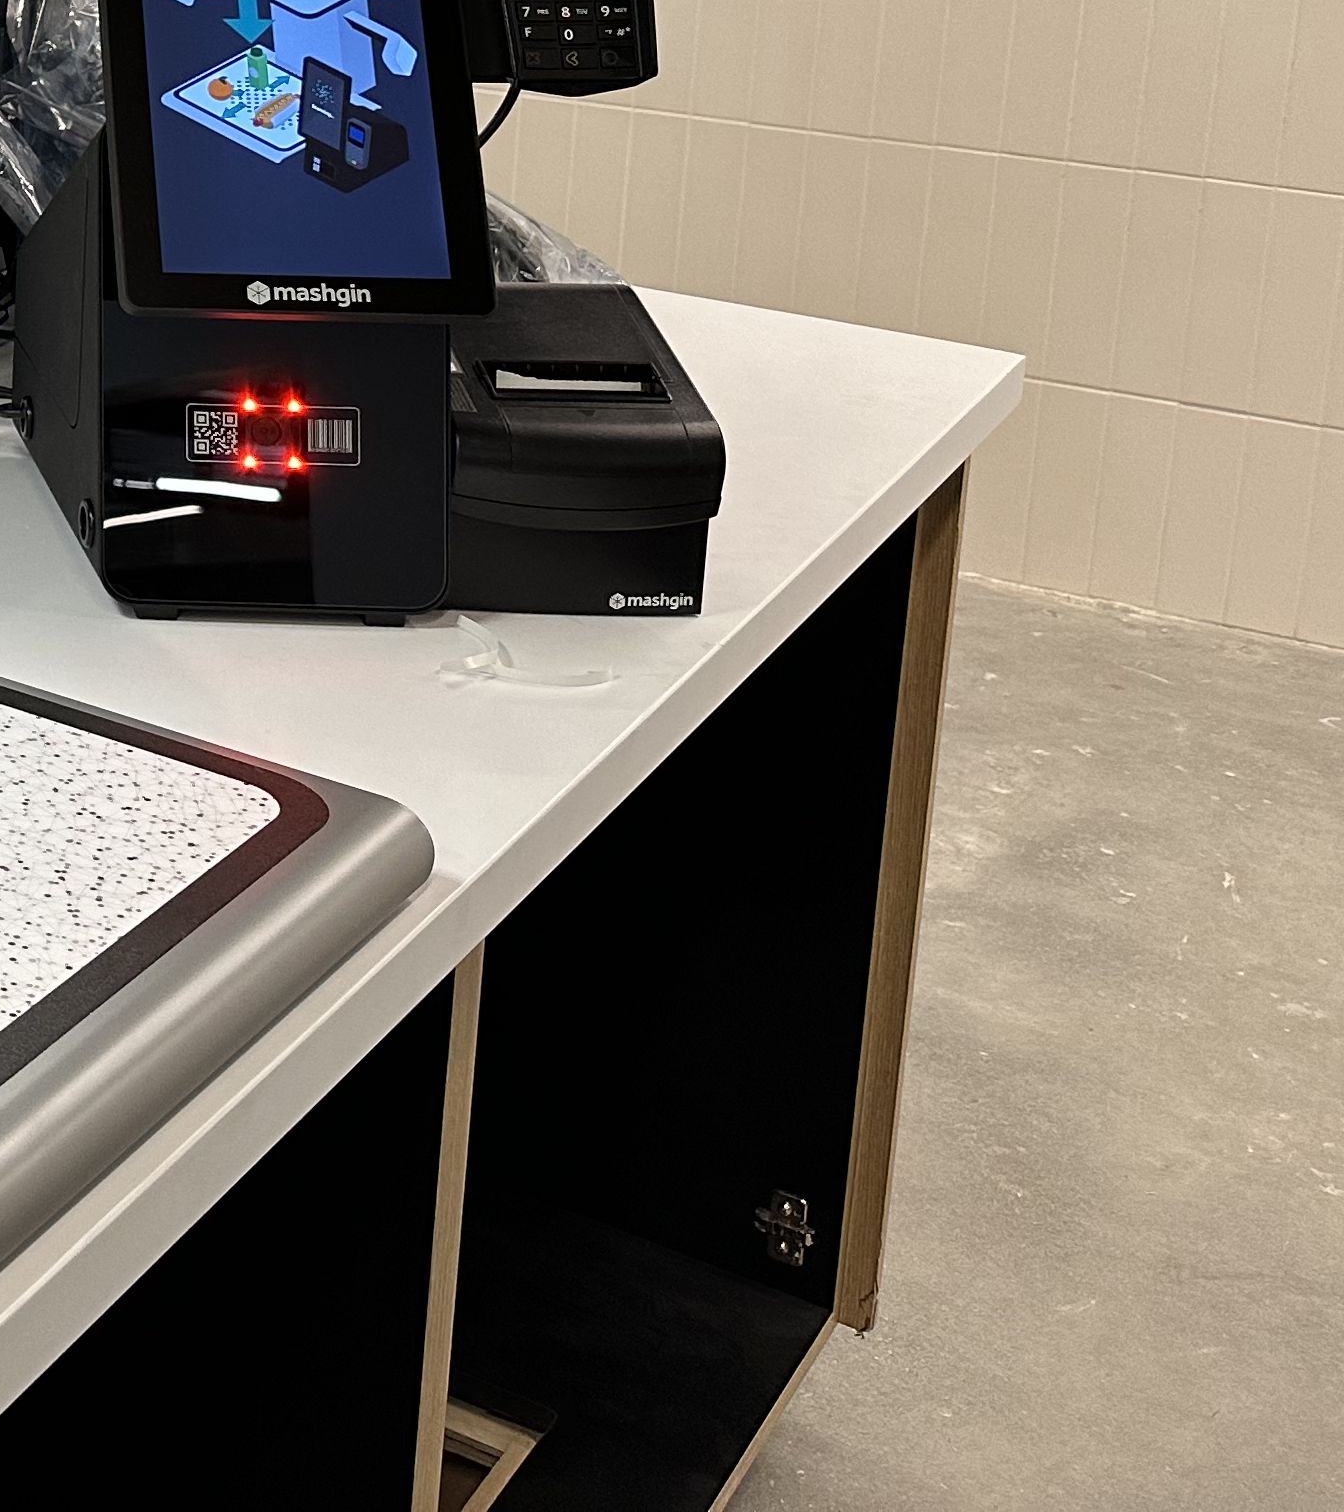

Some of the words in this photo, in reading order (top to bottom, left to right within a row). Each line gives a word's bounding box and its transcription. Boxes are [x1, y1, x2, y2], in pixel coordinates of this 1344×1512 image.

[521, 6, 531, 18] 7
[561, 6, 571, 18] 8
[600, 5, 610, 17] 9
[524, 27, 532, 38] F
[563, 28, 574, 41] 0
[273, 282, 372, 308] mashgin
[627, 592, 694, 610] mashgin
